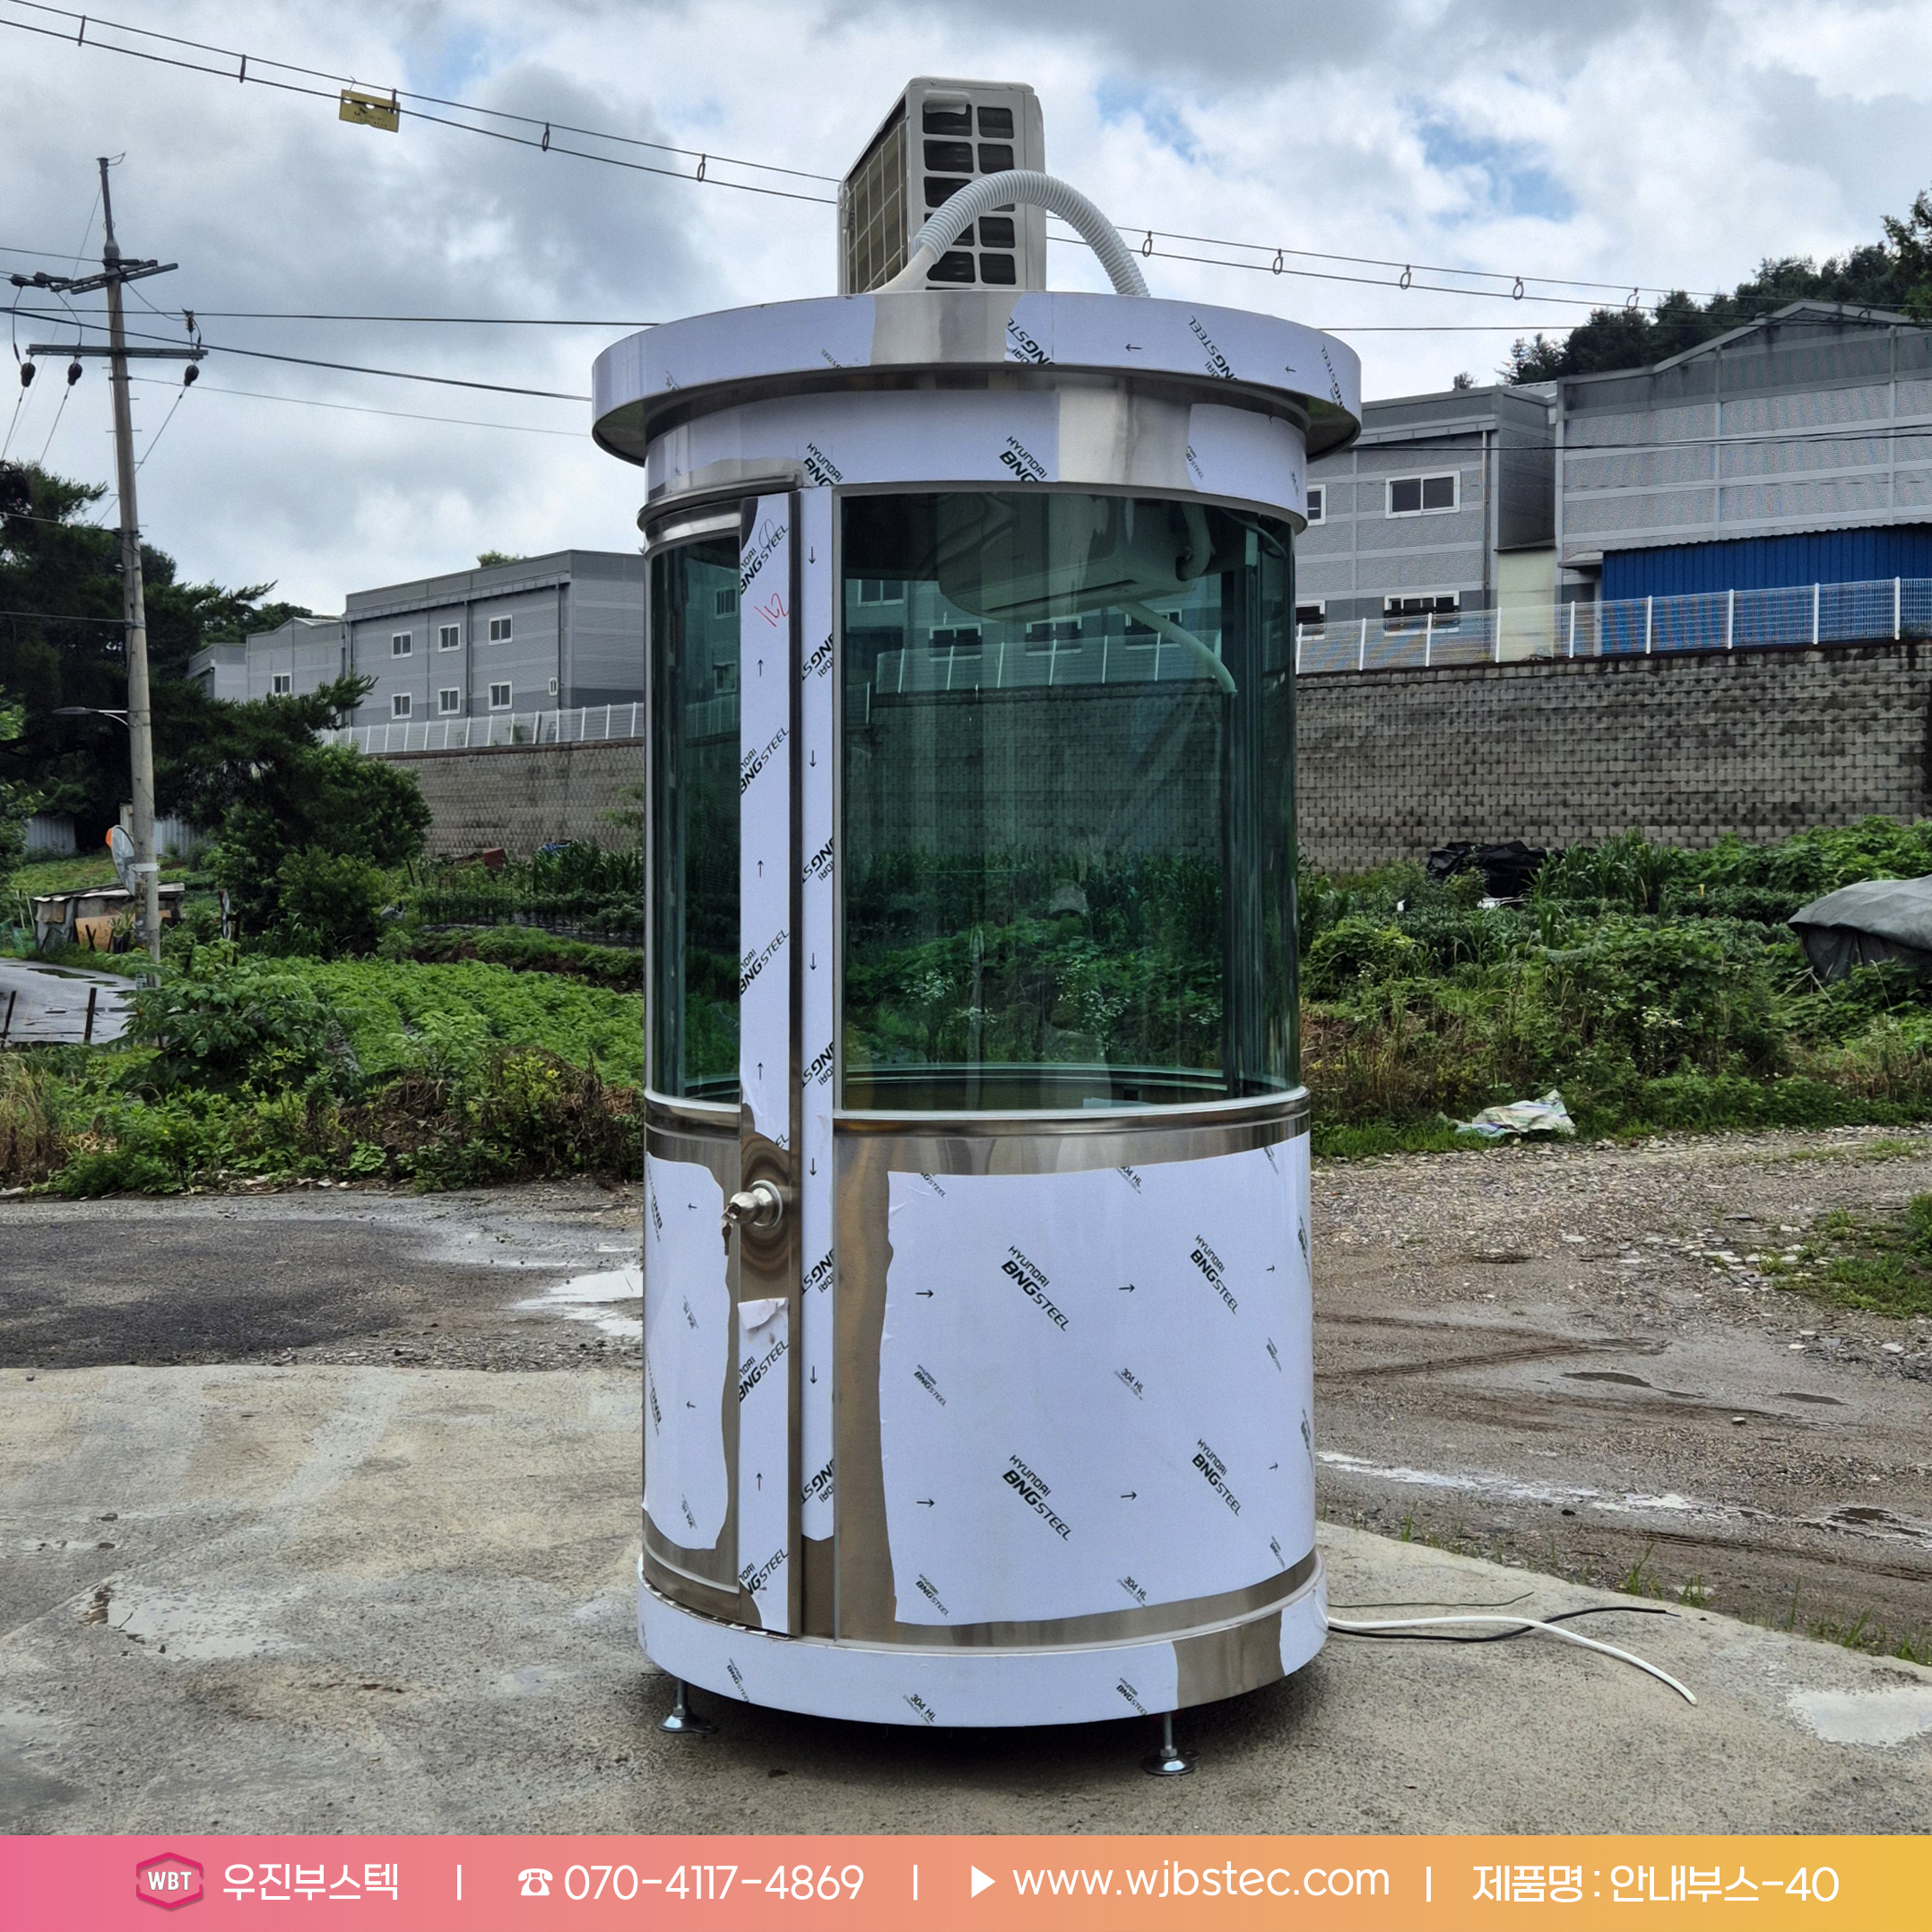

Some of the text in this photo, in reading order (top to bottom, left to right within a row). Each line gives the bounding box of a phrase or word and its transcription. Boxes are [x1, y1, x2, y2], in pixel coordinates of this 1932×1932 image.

[1189, 315, 1238, 380] NGSTEEL
[807, 443, 844, 482] HYUNDAI
[1006, 436, 1047, 479] HYUNDAI
[1008, 1245, 1050, 1287] HYUNDAI
[1194, 1234, 1226, 1273] HYUNDAI
[1001, 1260, 1070, 1332] BNGSTEEL
[1190, 1249, 1238, 1315] BNGSTEEL
[1009, 1454, 1052, 1497] HYUNDAI
[1197, 1438, 1227, 1477] HYUNDAI
[1002, 1469, 1071, 1541] BNGSTEEL
[1191, 1453, 1241, 1516] BNGSTEEL
[911, 1694, 926, 1710] 304
[924, 1708, 936, 1722] HL
